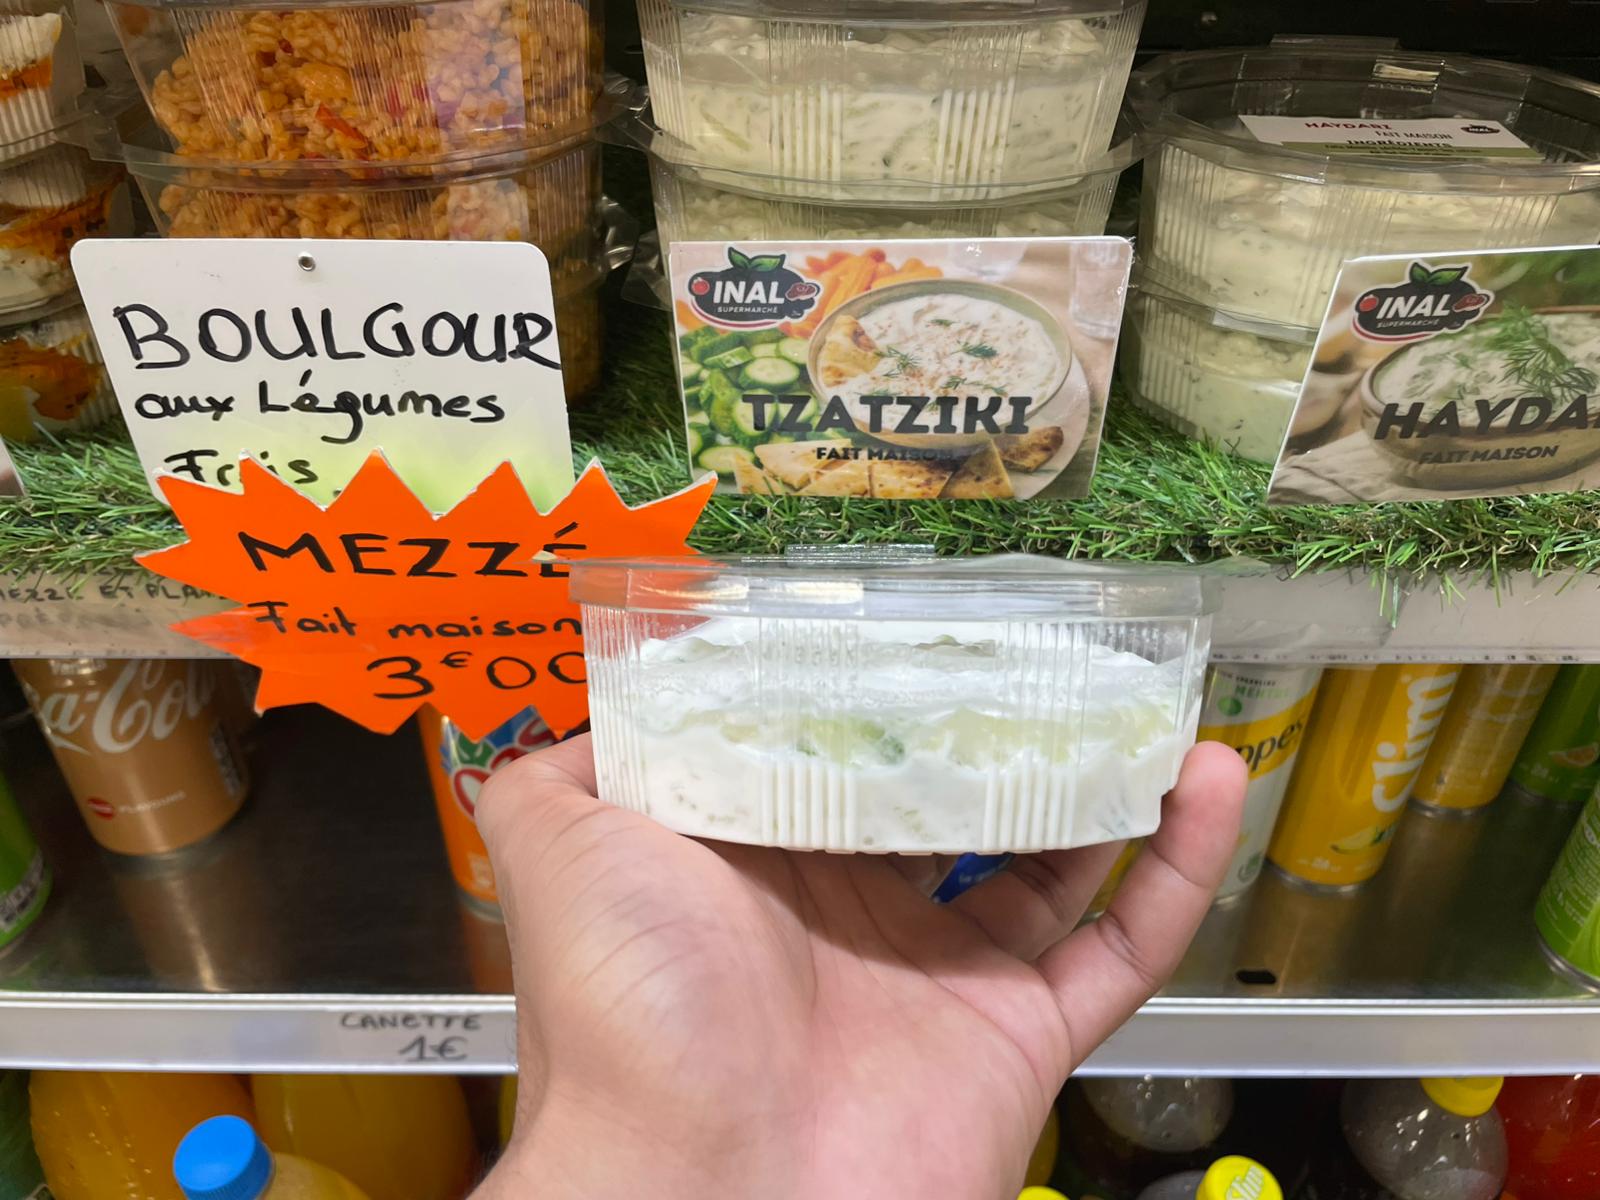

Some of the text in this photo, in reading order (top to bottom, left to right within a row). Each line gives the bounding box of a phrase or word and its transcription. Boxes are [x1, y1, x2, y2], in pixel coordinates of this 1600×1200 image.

[713, 280, 785, 304] INAL
[717, 305, 778, 314] SUPERMARCHÉ
[1376, 293, 1451, 319] INAL
[113, 302, 561, 370] BOULGOUR
[135, 368, 505, 443] aux Légumes
[742, 394, 1033, 434] TZATZIKI
[816, 447, 862, 460] FAIT
[1418, 445, 1560, 465] FAIT MAISON
[163, 449, 319, 486] Fris
[238, 521, 587, 578] MEZZÉ
[247, 601, 583, 639] Fait maison
[341, 1012, 481, 1031] CANETTE
[397, 1035, 469, 1062] 1€
